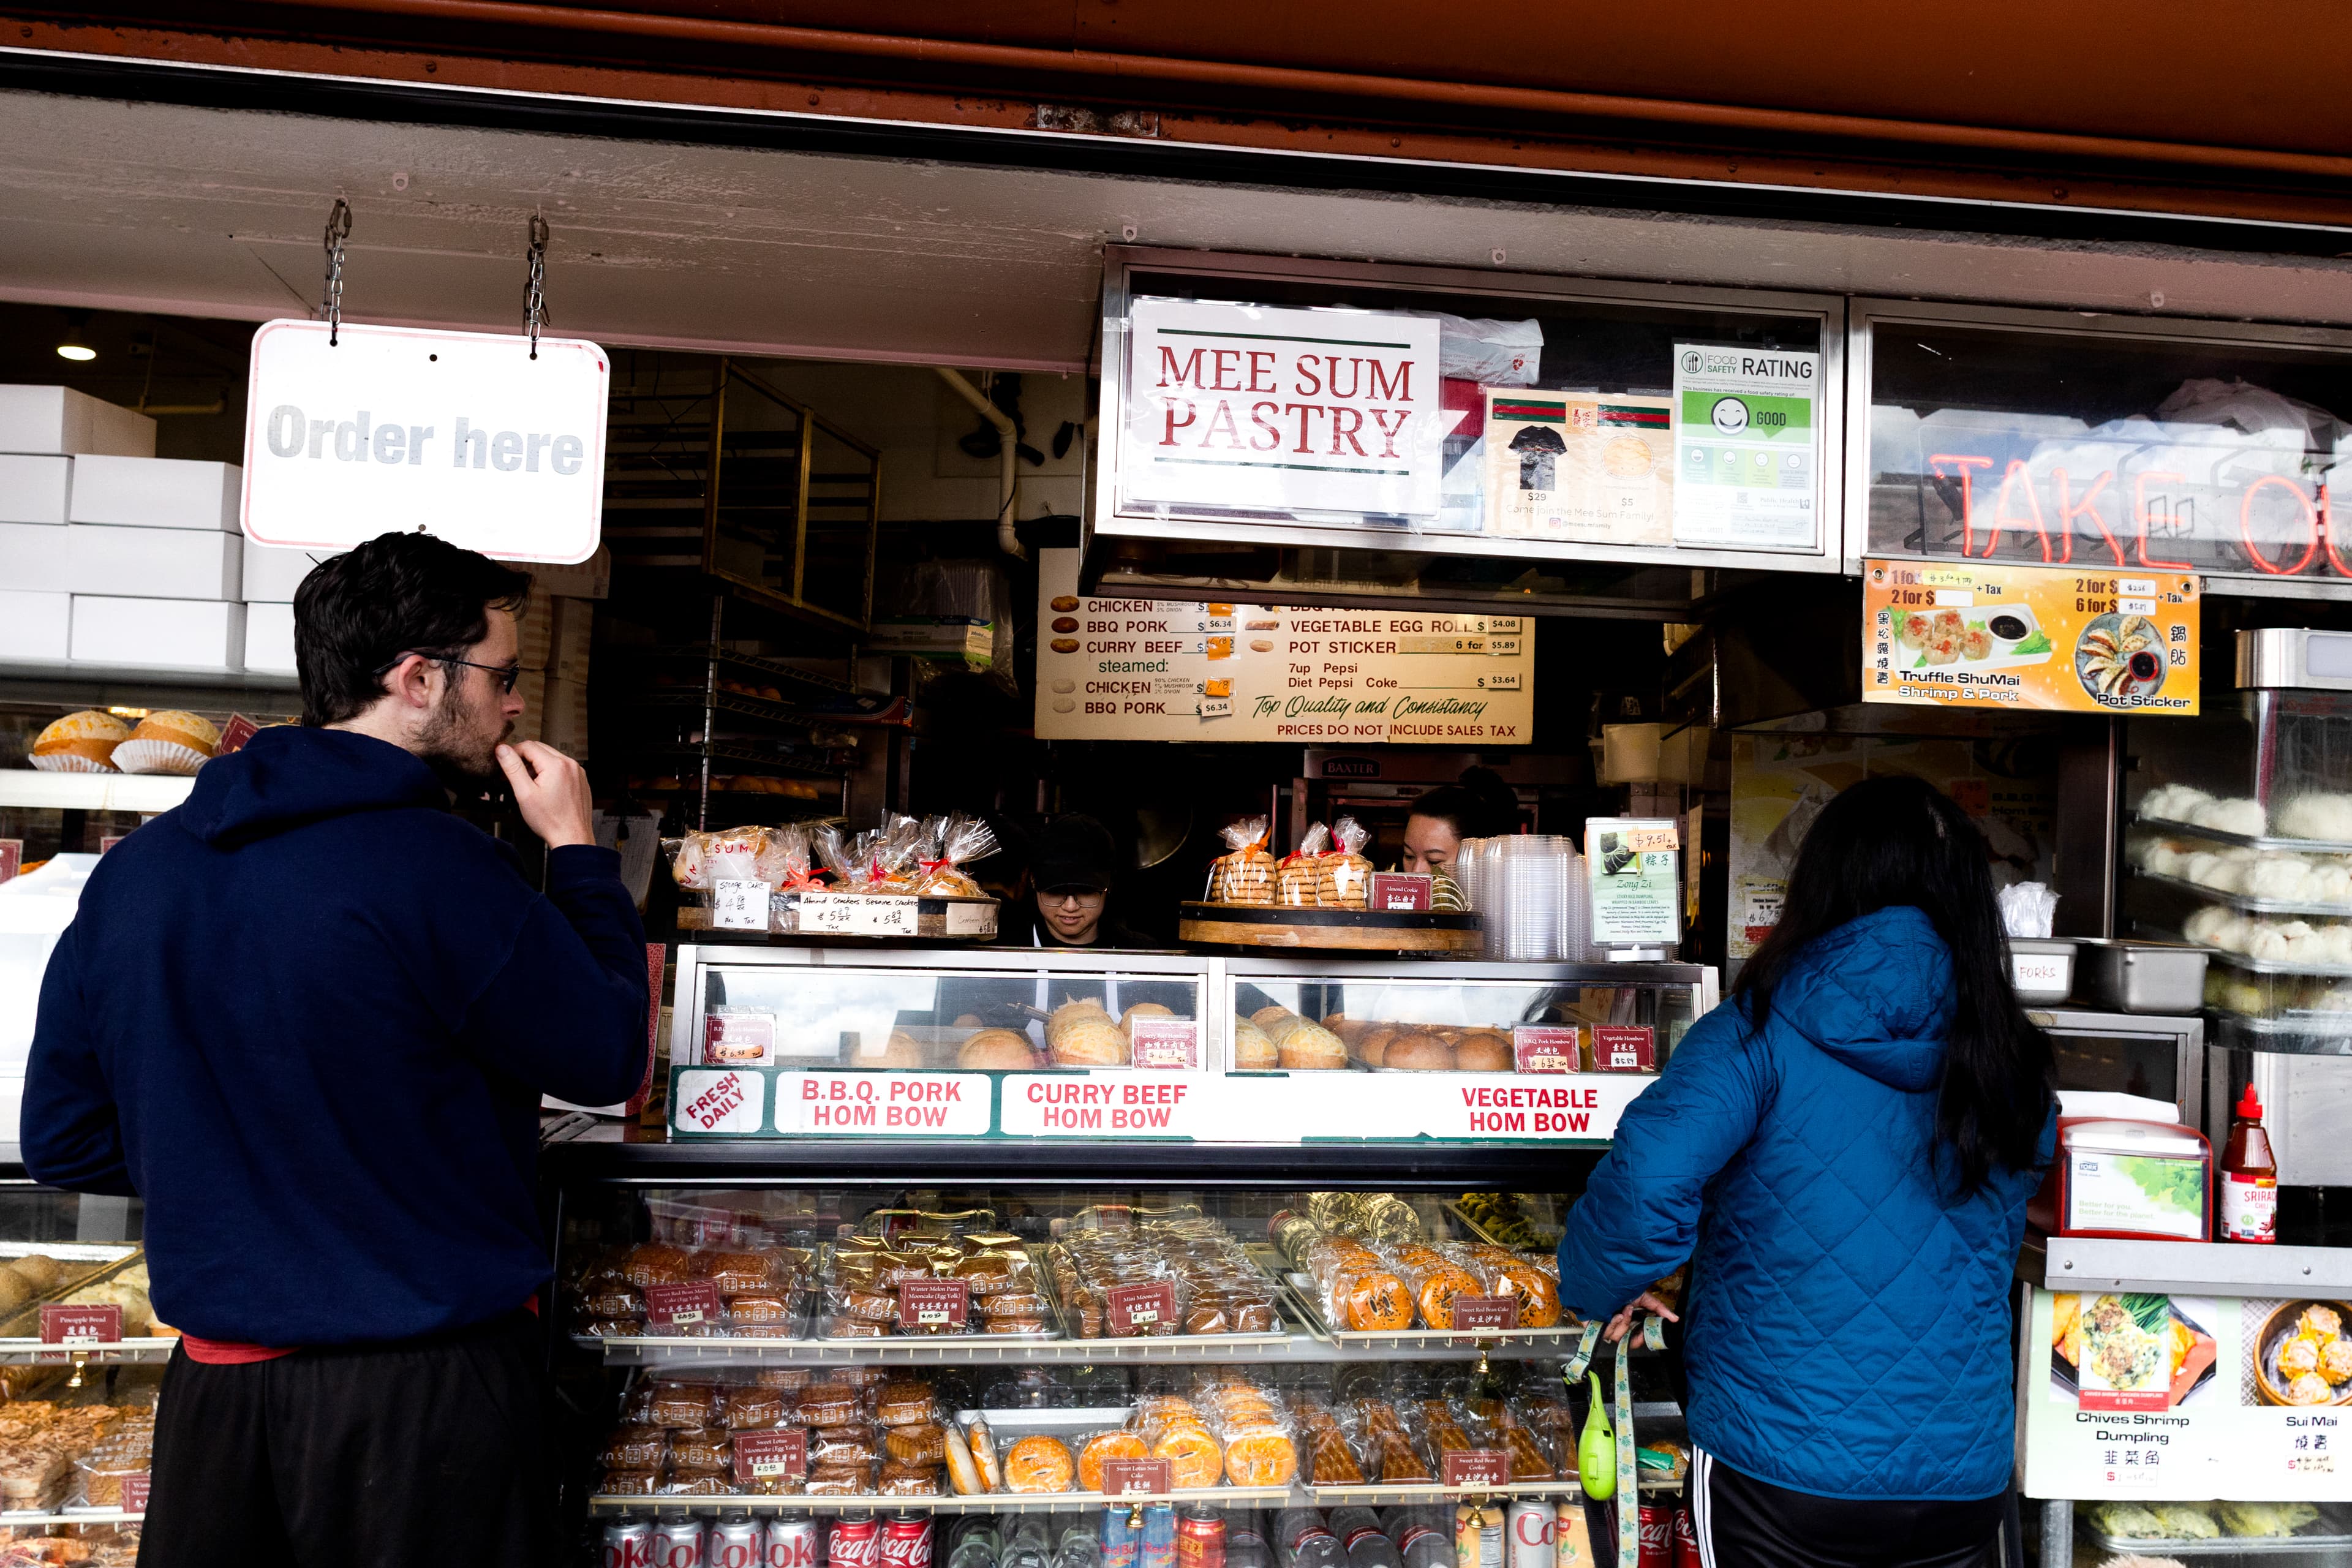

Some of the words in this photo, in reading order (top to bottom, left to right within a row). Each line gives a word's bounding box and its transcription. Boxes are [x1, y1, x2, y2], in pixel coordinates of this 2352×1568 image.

[1156, 346, 1276, 393] MEE
[1295, 353, 1415, 401] SUM
[1707, 355, 1737, 365] FOOD
[1742, 357, 1812, 379] RATING
[1707, 365, 1736, 374] SAFETY
[1756, 412, 1787, 426] GOOD
[1158, 396, 1412, 459] PASTRY
[267, 404, 434, 466] Order
[454, 417, 583, 475] here
[1528, 492, 1547, 502] $29
[1621, 497, 1634, 507] $5
[1506, 504, 1534, 514] Come
[1536, 505, 1555, 516] join
[1557, 506, 1572, 516] the
[1574, 507, 1594, 517] Mee
[1596, 507, 1617, 519] Sum
[1619, 510, 1654, 521] Family!
[1929, 453, 2193, 570] TAKE
[1562, 520, 1611, 530] @meesumfamily
[1891, 570, 1898, 584] 1
[1985, 584, 2002, 595] Tax
[2075, 578, 2084, 593] 2
[2086, 579, 2106, 594] for
[1891, 589, 1901, 604] 2
[1902, 589, 1923, 605] for
[2166, 592, 2184, 604] Tax
[1088, 600, 1153, 612] CHICKEN
[2075, 597, 2085, 612] 6
[2087, 598, 2106, 614] for
[1087, 620, 1119, 633] BBQ
[1126, 620, 1168, 633] PORK
[1290, 620, 1382, 633] VEGETABLE
[1390, 620, 1423, 633] EGG
[1431, 620, 1474, 633] ROLL
[1492, 619, 1516, 628] $4.08
[1087, 641, 1137, 654] CURRY
[1144, 641, 1183, 654] BEEF
[1289, 641, 1321, 654] POT
[1329, 641, 1397, 654] STICKER
[1455, 640, 1463, 650] 6
[1467, 639, 1484, 650] for
[1491, 640, 1516, 650] $5.89
[2170, 625, 2187, 666] 鍋貼
[1098, 658, 1169, 673] steamed:
[1289, 663, 1311, 676] 7up
[1323, 662, 1359, 676] Pepsi
[1288, 677, 1313, 688] Diet
[1319, 677, 1354, 691] Pepsi
[1365, 677, 1398, 688] Coke
[1491, 676, 1516, 684] $3.64
[1899, 670, 1954, 684] Truffle
[1957, 673, 2021, 687] ShuMai
[1085, 681, 1152, 694] CHICKEN
[1898, 685, 1959, 701] Shrimp
[1961, 687, 1975, 700] &
[1978, 688, 2019, 702] Pork
[2097, 694, 2129, 706] Pot
[2130, 695, 2191, 708] Sticker
[1085, 702, 1117, 715] BBQ
[1124, 702, 1166, 714] PORK
[1205, 703, 1228, 712] $6.34
[1253, 695, 1282, 719] Top
[1284, 695, 1351, 720] Quality
[1354, 696, 1391, 715] and
[1392, 695, 1489, 722] Consistancy
[1277, 724, 1324, 736] PRICES
[1327, 724, 1349, 736] DO
[1354, 725, 1384, 736] NOT
[1390, 724, 1444, 736] INCLUDE
[1446, 725, 1484, 736] SALES
[1490, 725, 1517, 737] TAX
[1327, 761, 1374, 775] BAXTER
[715, 843, 749, 854] SUM
[719, 881, 742, 894] Sponge
[747, 881, 765, 890] Cake
[1616, 880, 1639, 892] Zong
[1641, 879, 1652, 888] Zi
[803, 896, 828, 905] Almond
[832, 897, 861, 905] Crackers
[865, 897, 892, 907] Sesame
[894, 897, 920, 907] Crackers
[744, 916, 755, 925] Tax
[2018, 965, 2057, 981] FORKS
[685, 1071, 741, 1120] FRESH
[802, 1079, 880, 1102] B.B.Q.
[890, 1081, 962, 1102] PORK
[1027, 1083, 1116, 1105] CURRY
[1123, 1084, 1188, 1106] BEEF
[1461, 1087, 1598, 1108] VEGETABLE
[700, 1087, 745, 1130] DAILY
[813, 1105, 878, 1127] HOM
[886, 1106, 948, 1127] BOW
[1043, 1107, 1103, 1128] HOM
[1111, 1107, 1172, 1129] BOW
[1470, 1112, 1525, 1132] HOM
[1534, 1113, 1590, 1133] BOW
[2079, 1163, 2098, 1172] TORK
[2078, 1199, 2102, 1208] Better
[2078, 1208, 2102, 1216] Better
[2130, 1211, 2155, 1221] planet.
[2075, 1412, 2130, 1425] Chives
[2133, 1414, 2190, 1428] Shrimp
[2286, 1415, 2309, 1427] Sui
[2311, 1415, 2338, 1427] Mai
[2095, 1430, 2169, 1446] Dumpling
